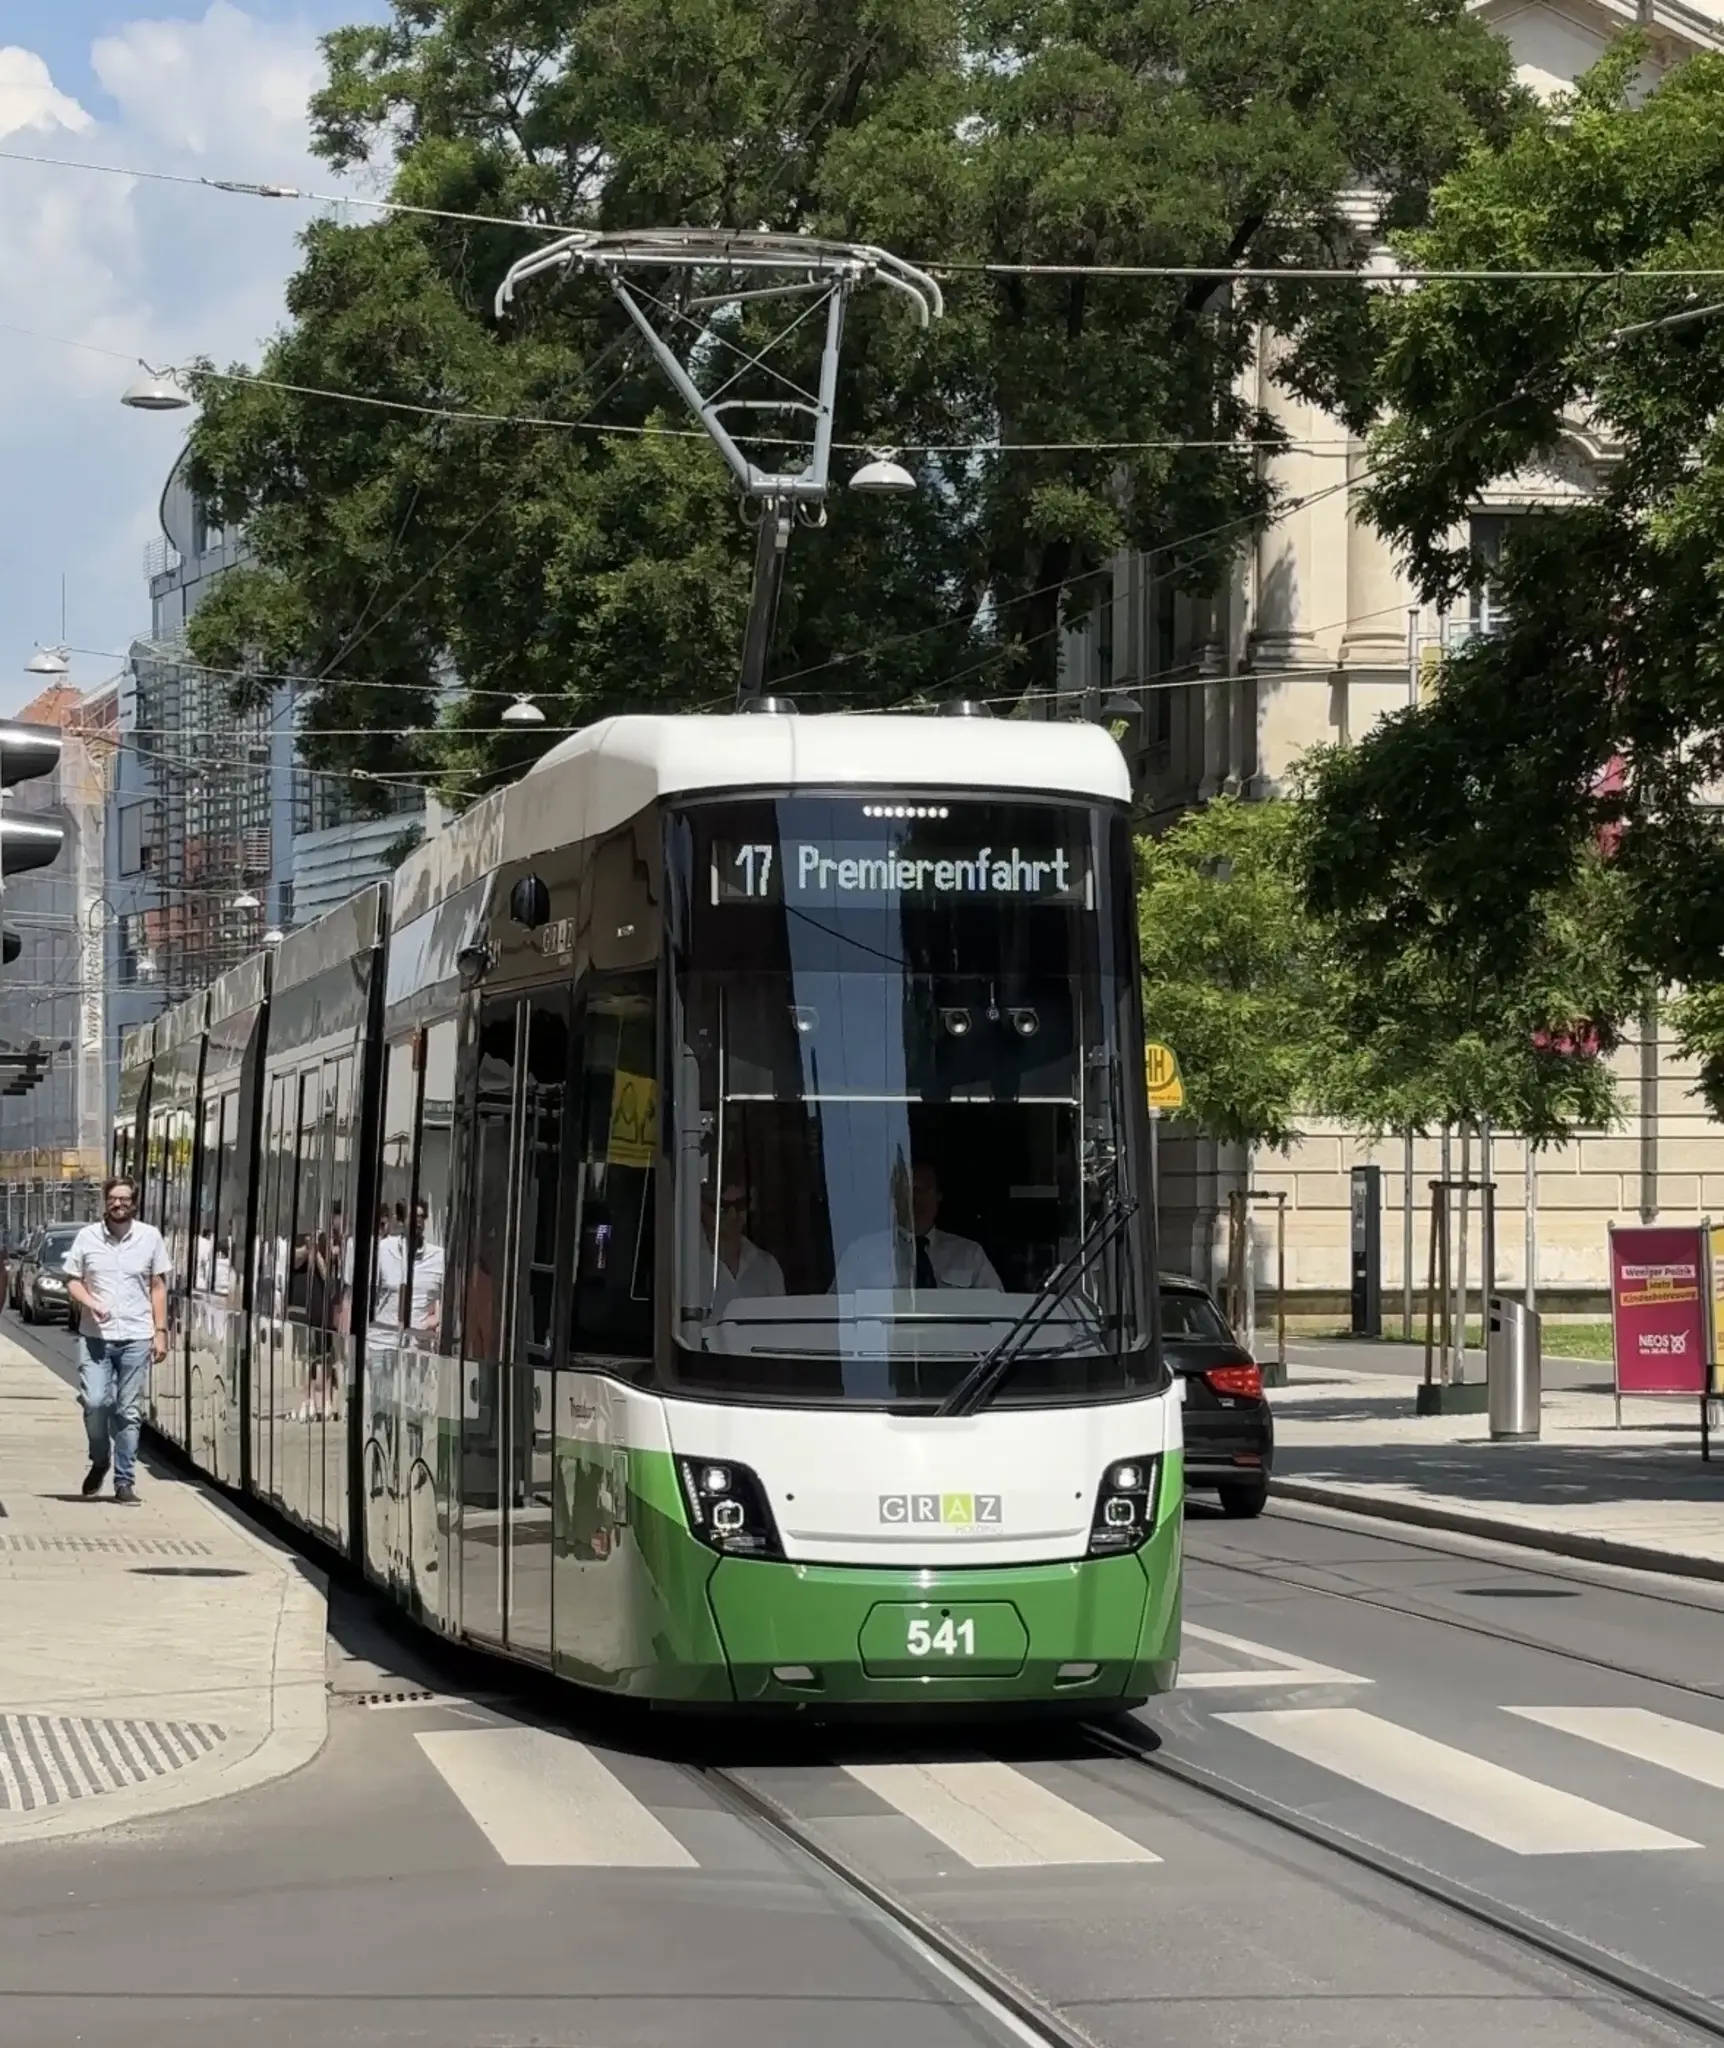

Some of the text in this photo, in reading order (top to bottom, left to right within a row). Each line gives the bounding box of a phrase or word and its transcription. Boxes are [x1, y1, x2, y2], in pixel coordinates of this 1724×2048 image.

[735, 844, 1071, 897] 17 Premierenfahrt
[1638, 1334, 1670, 1347] NEOS
[881, 1496, 999, 1521] GRAZ
[907, 1619, 975, 1656] 541
